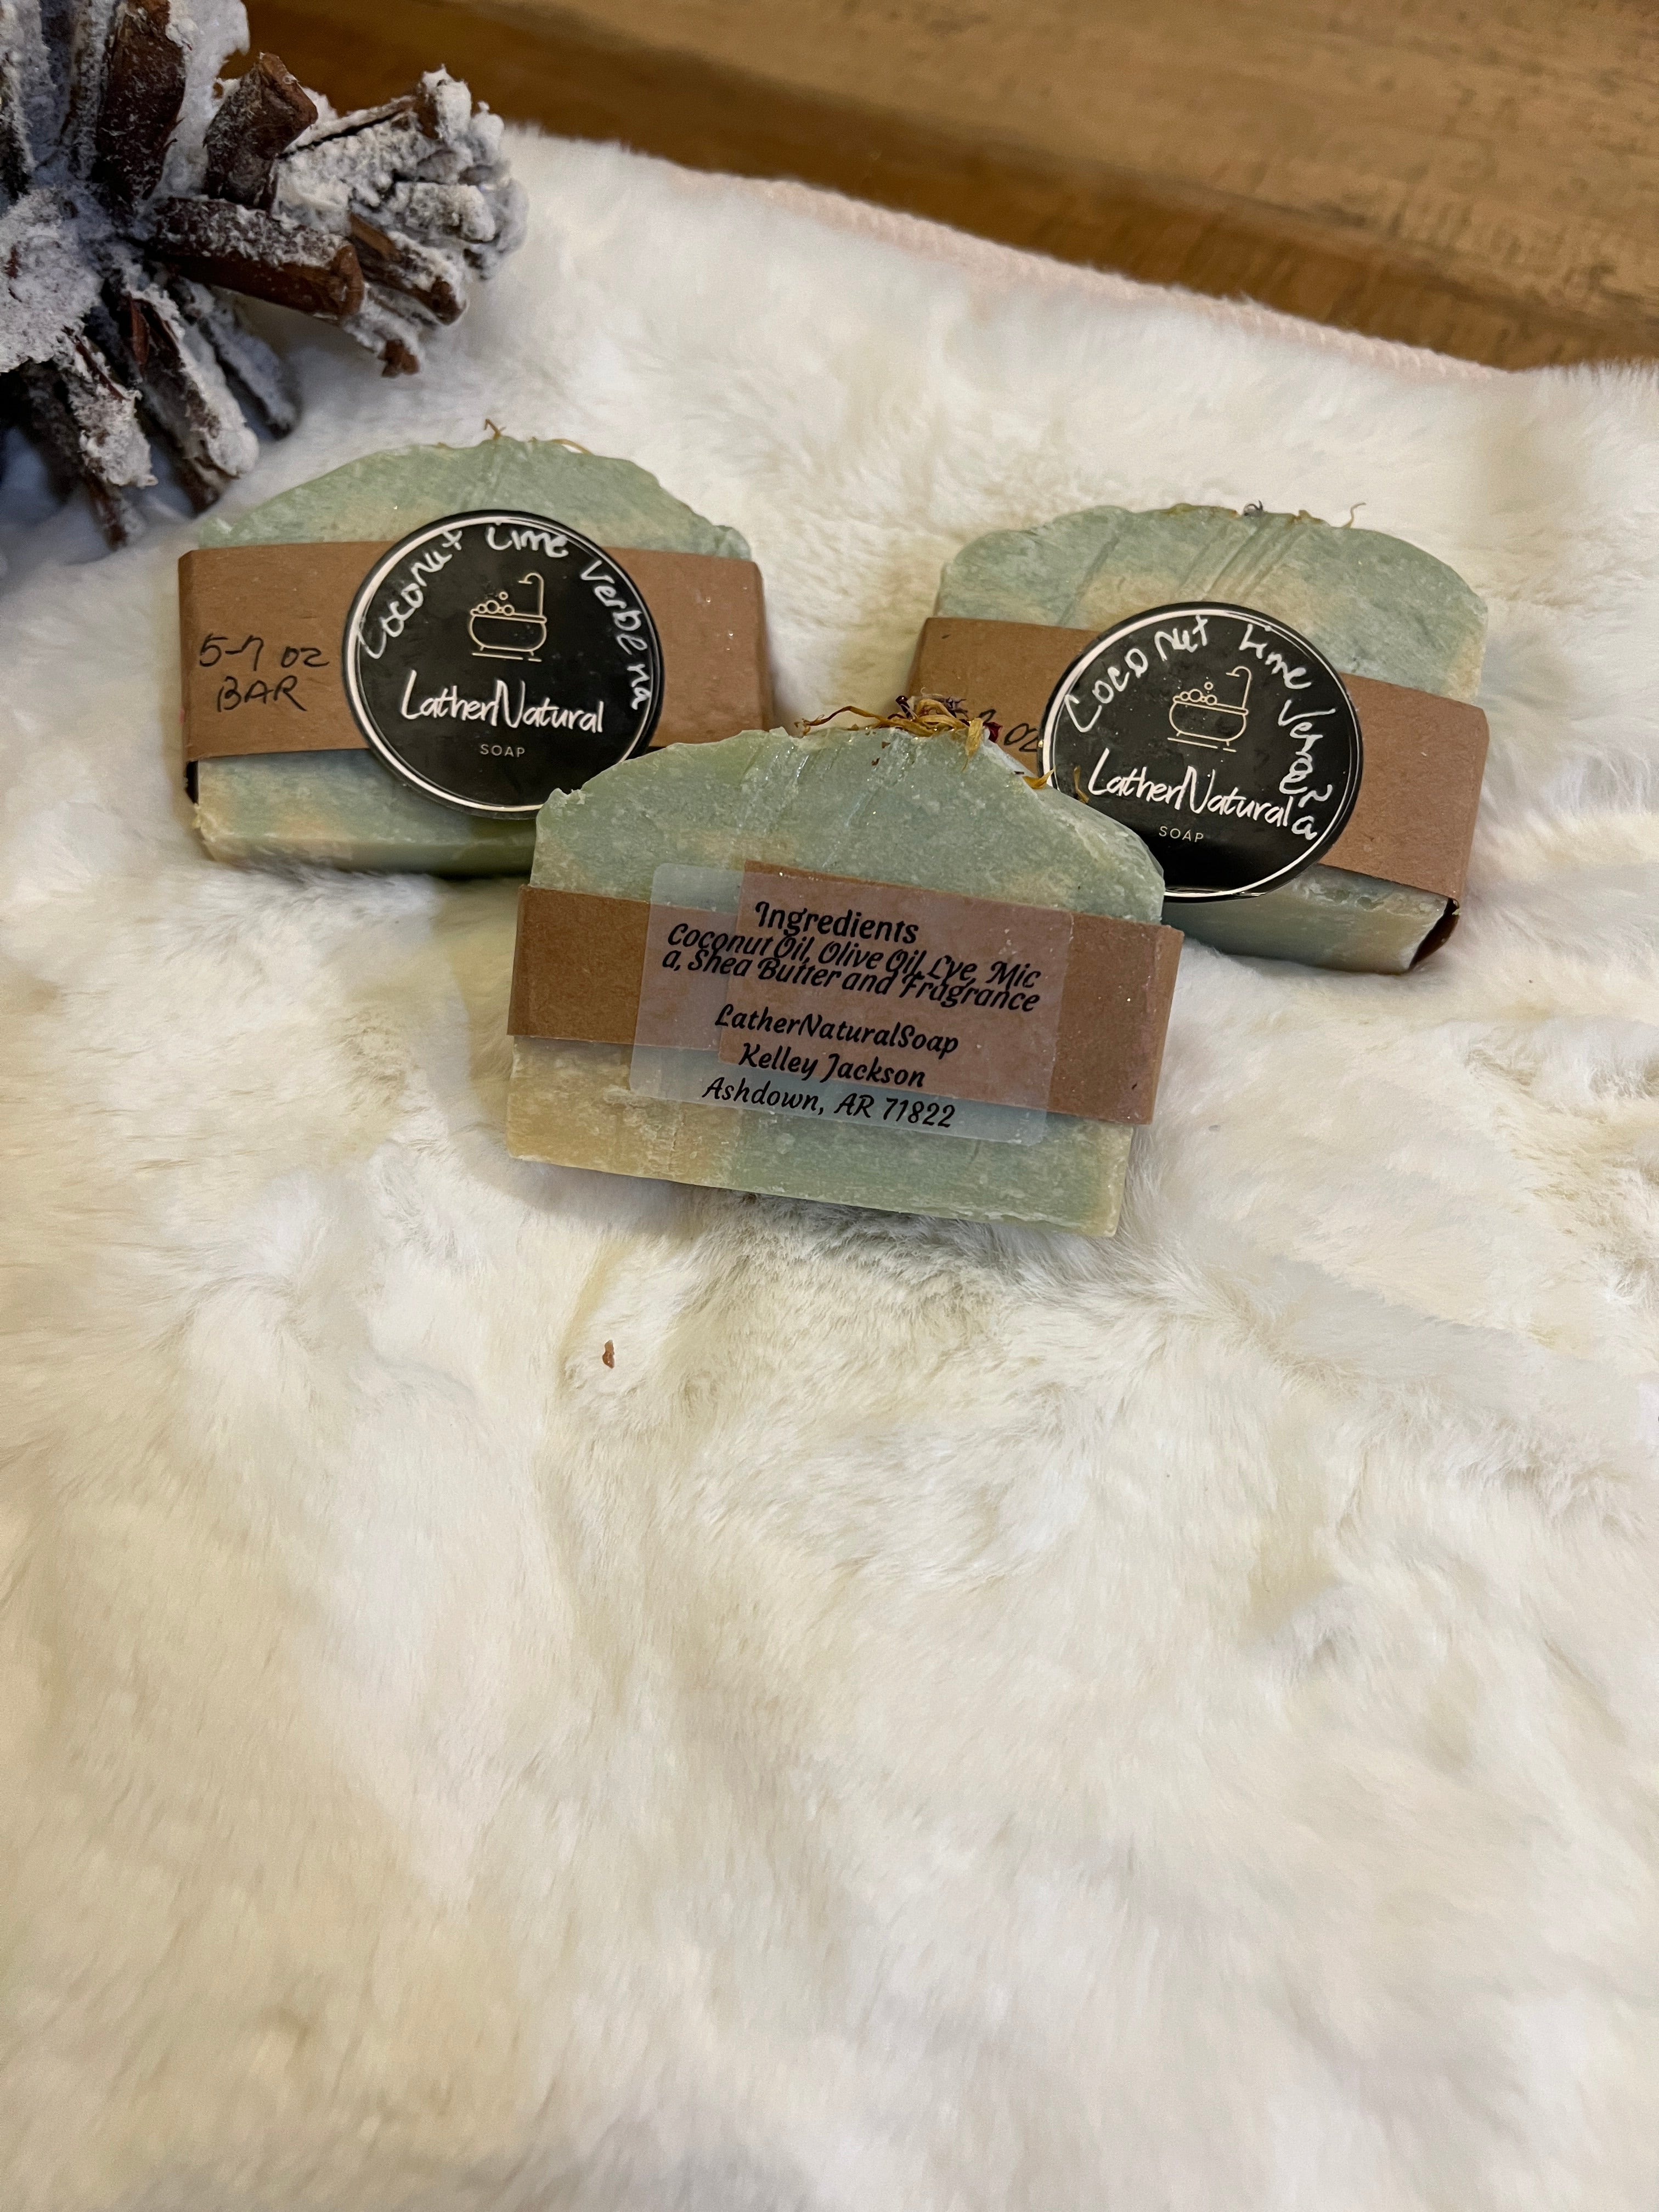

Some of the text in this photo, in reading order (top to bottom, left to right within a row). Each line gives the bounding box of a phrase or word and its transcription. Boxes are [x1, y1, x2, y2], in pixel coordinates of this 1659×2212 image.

[217, 675, 307, 712] BAR
[479, 744, 526, 758] SOAP
[1158, 825, 1204, 843] SOAP
[755, 901, 919, 944] Ingredients
[668, 923, 774, 956] Coconut
[818, 940, 884, 970] Olive
[985, 961, 1041, 989] Mic
[662, 949, 1040, 1012] a, Shea Butter and Fragrance
[714, 1003, 959, 1059] LatherNaturalSoap
[738, 1043, 926, 1088] Kelley Jackson
[702, 1077, 956, 1128] Ashdown, AR 71822
